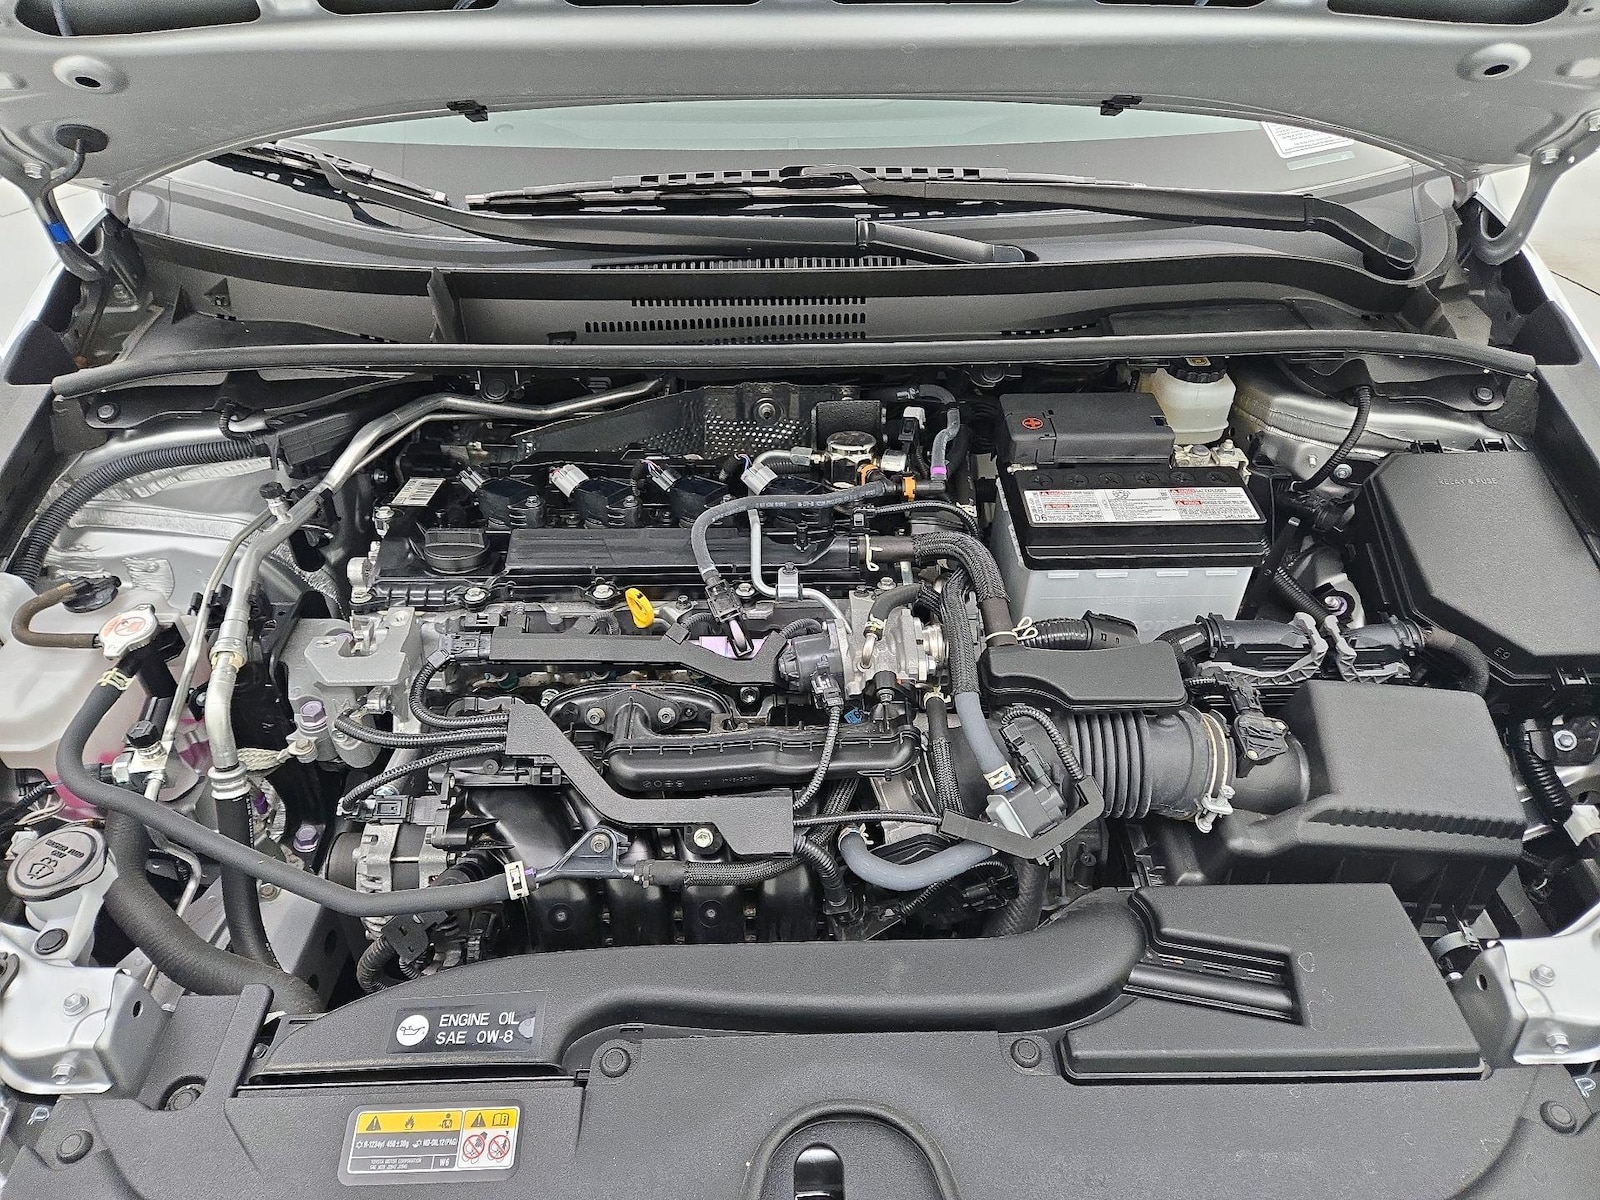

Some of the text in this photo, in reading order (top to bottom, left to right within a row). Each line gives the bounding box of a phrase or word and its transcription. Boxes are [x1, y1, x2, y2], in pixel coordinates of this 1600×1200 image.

[1034, 513, 1048, 522] D6
[1493, 646, 1511, 660] E9
[438, 1011, 520, 1028] ENGINE OIL
[435, 1030, 514, 1045] SAE 0W-8
[439, 1158, 450, 1167] W6
